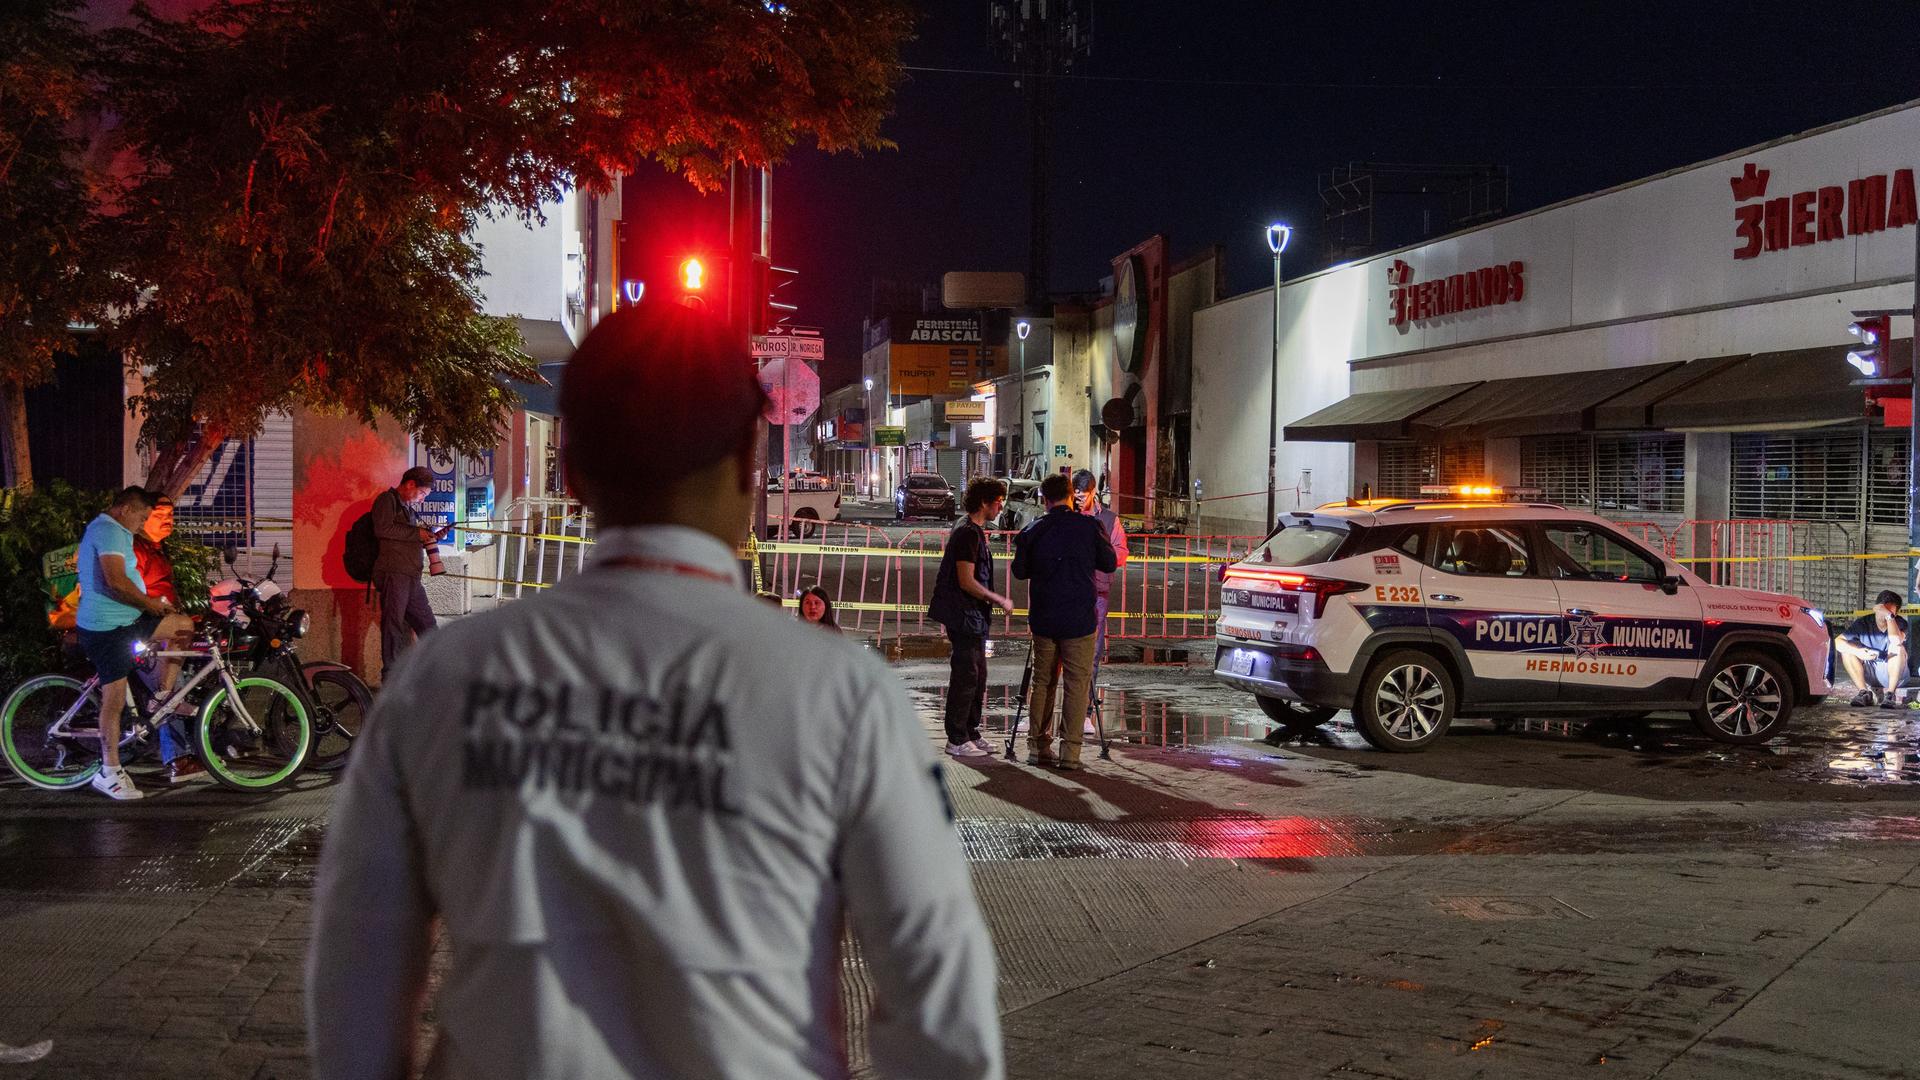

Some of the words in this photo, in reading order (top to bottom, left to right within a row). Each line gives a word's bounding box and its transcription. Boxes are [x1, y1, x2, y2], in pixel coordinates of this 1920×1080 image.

[1734, 203, 1763, 260] 3
[1764, 168, 1918, 252] HERMA
[1406, 260, 1524, 321] HERMANOS
[916, 318, 979, 329] FERRETERÍA
[910, 329, 982, 341] ABASCAL
[800, 342, 823, 354] NORIEGA
[431, 479, 454, 492] TOS
[423, 501, 455, 513] REVISAR
[1251, 594, 1286, 610] MUNICIPAL
[1375, 586, 1387, 602] E
[1389, 586, 1420, 603] 232
[1475, 618, 1557, 644] POLICÍA
[1613, 626, 1693, 649] MUNICIPAL
[1526, 659, 1637, 676] HERMOSILLO
